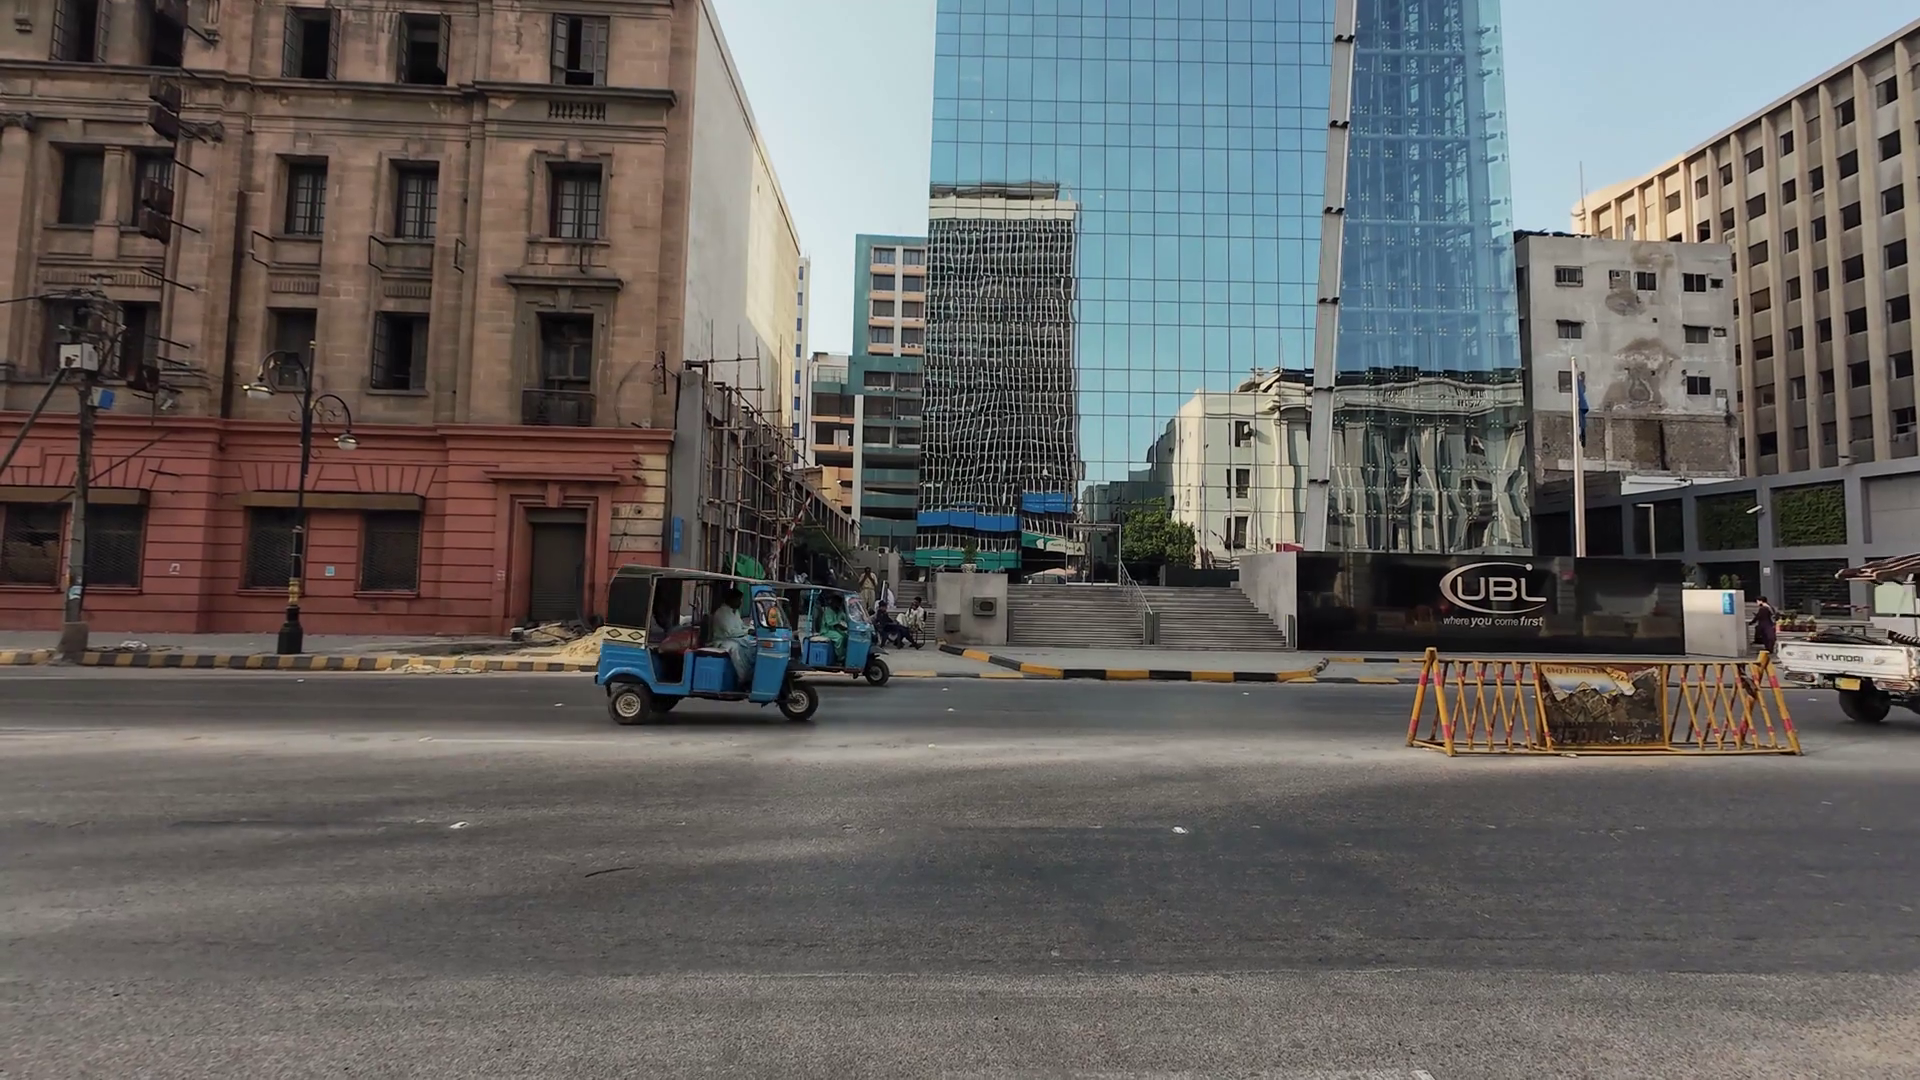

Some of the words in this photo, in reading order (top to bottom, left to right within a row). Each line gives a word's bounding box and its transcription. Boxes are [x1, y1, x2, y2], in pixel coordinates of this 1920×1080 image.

[1457, 576, 1547, 601] UBL
[1443, 616, 1469, 625] where
[1471, 617, 1492, 627] you
[1494, 618, 1519, 626] come
[1520, 616, 1544, 626] first
[1816, 653, 1864, 662] HYUNDAI
